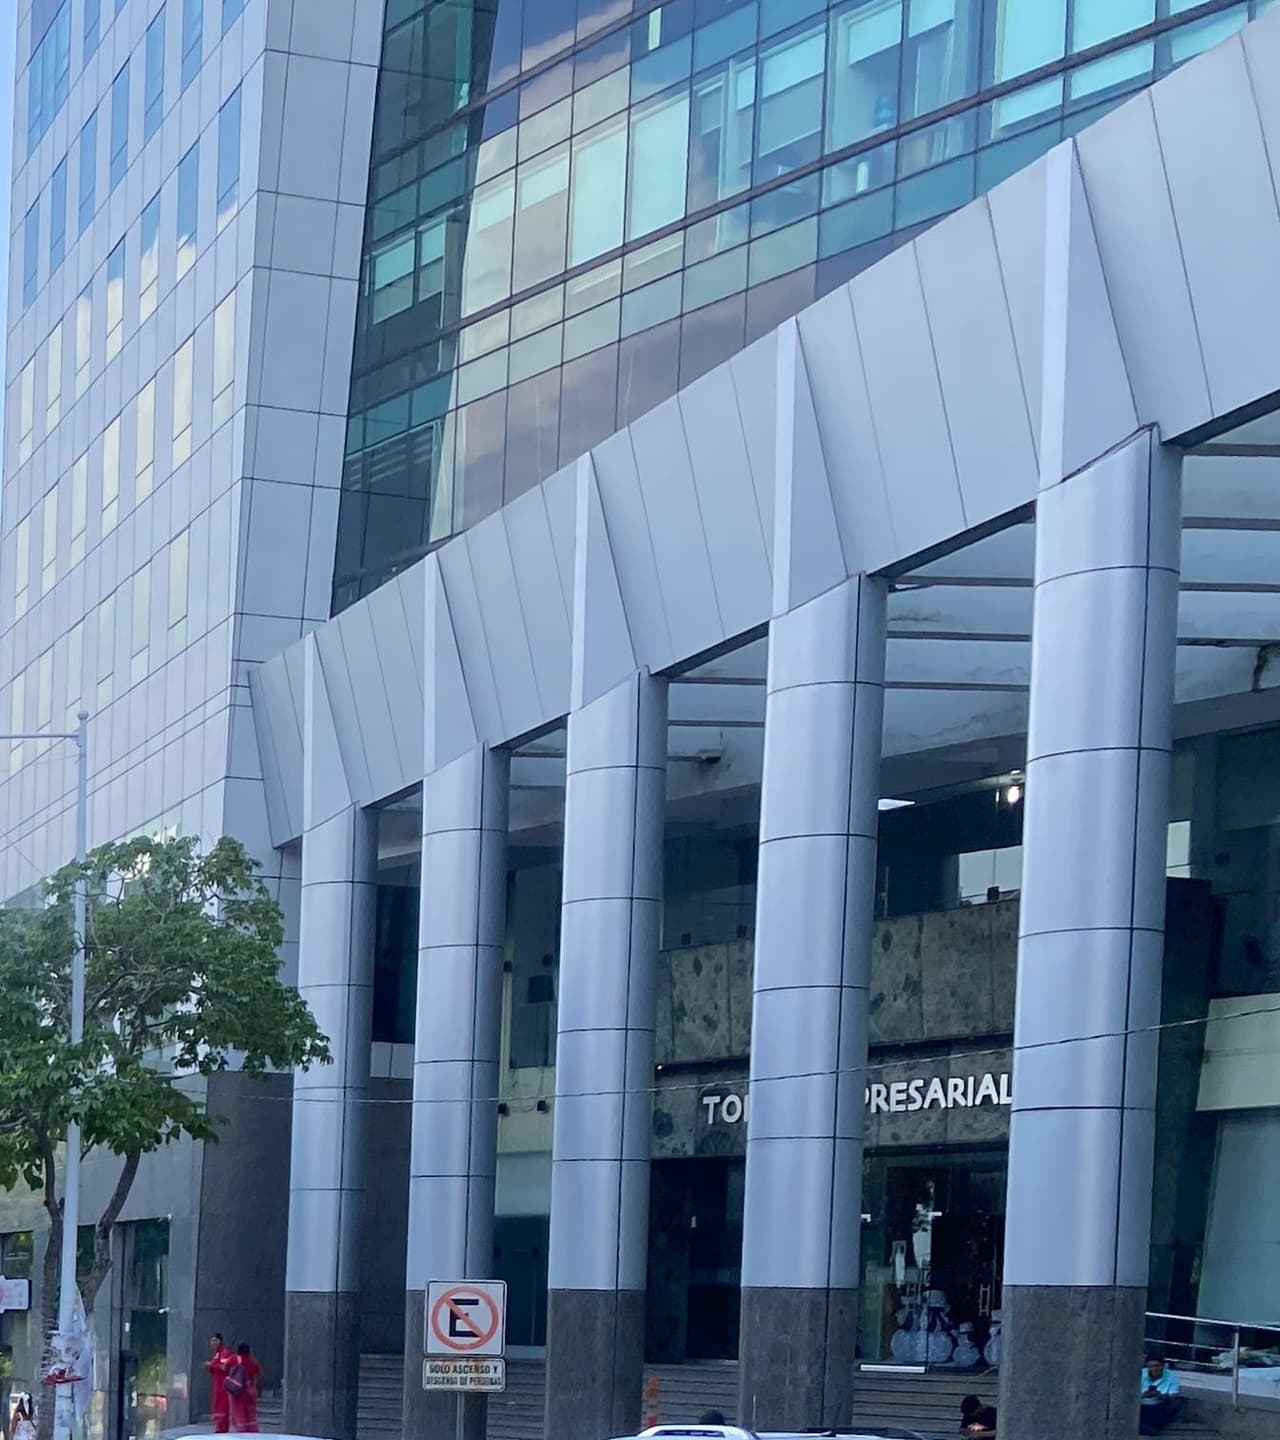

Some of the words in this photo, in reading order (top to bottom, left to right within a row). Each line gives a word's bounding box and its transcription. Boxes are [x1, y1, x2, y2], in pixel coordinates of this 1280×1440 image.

[865, 1073, 1013, 1113] RESARIAL
[429, 1364, 450, 1374] SOLO
[452, 1364, 490, 1374] ASCENSO
[493, 1365, 499, 1374] Y
